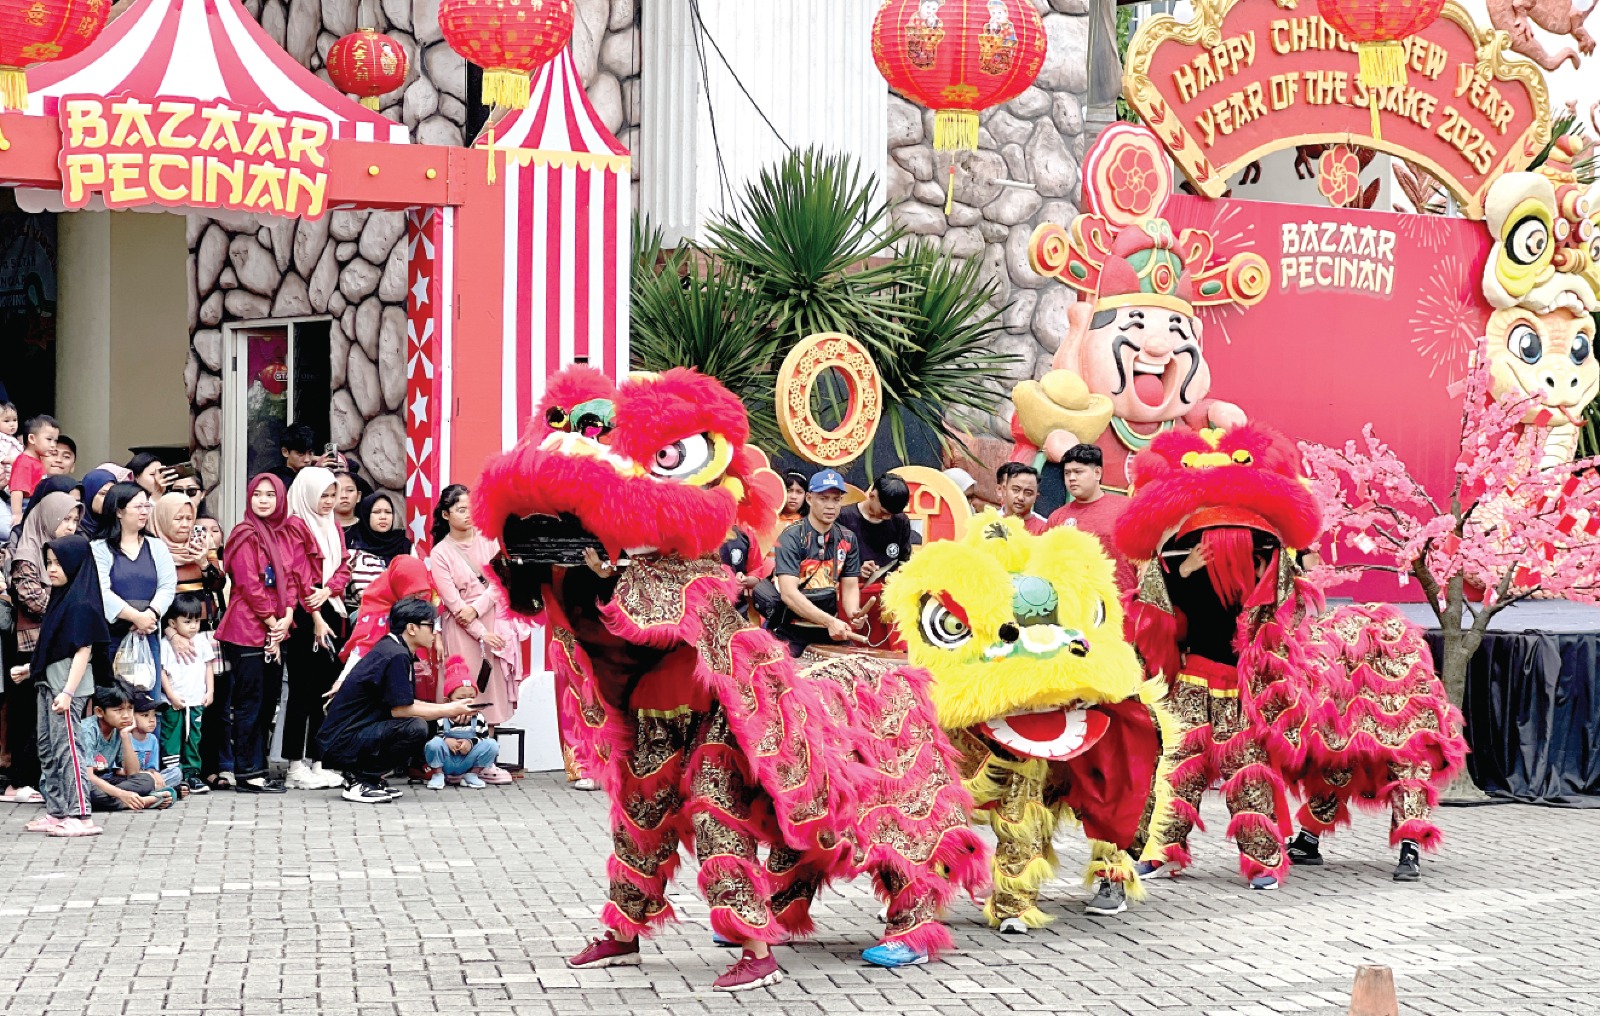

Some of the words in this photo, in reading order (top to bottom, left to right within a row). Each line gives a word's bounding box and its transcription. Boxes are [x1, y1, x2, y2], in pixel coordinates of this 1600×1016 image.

[1172, 30, 1255, 104] HAPPY
[1271, 15, 1359, 54] CHIN
[1454, 63, 1515, 135] YEAR
[66, 97, 328, 167] BAZAAR
[1195, 81, 1268, 147] YEAR
[1269, 72, 1299, 111] OF
[1302, 70, 1348, 105] THE
[1435, 105, 1497, 175] 2025
[66, 153, 328, 216] PECINAN
[1281, 220, 1396, 262] BAZAAR
[1281, 256, 1395, 294] PECINAN
